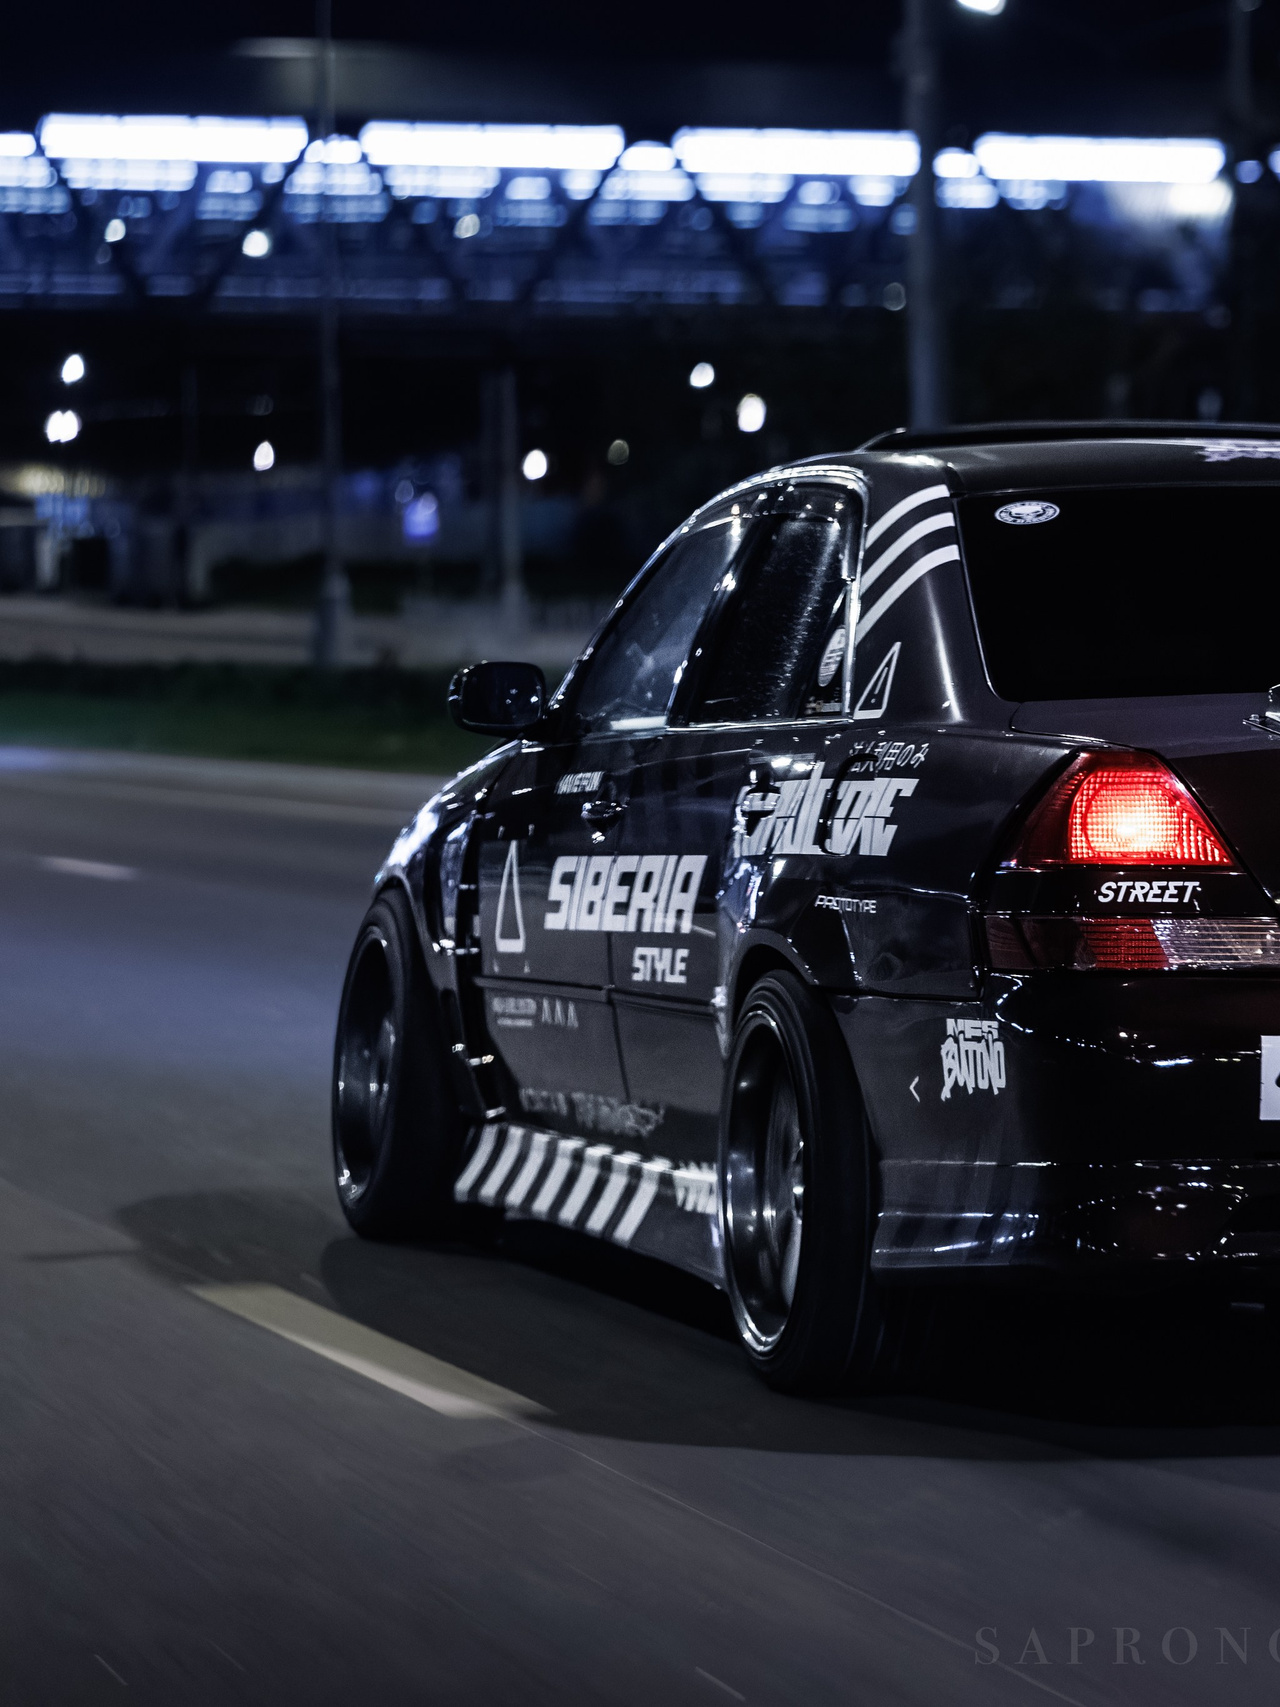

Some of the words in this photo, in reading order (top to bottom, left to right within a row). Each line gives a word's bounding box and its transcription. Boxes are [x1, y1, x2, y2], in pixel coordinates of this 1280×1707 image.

[544, 854, 709, 934] SIBERIA
[1098, 880, 1201, 903] STREET
[631, 946, 690, 984] STYLE
